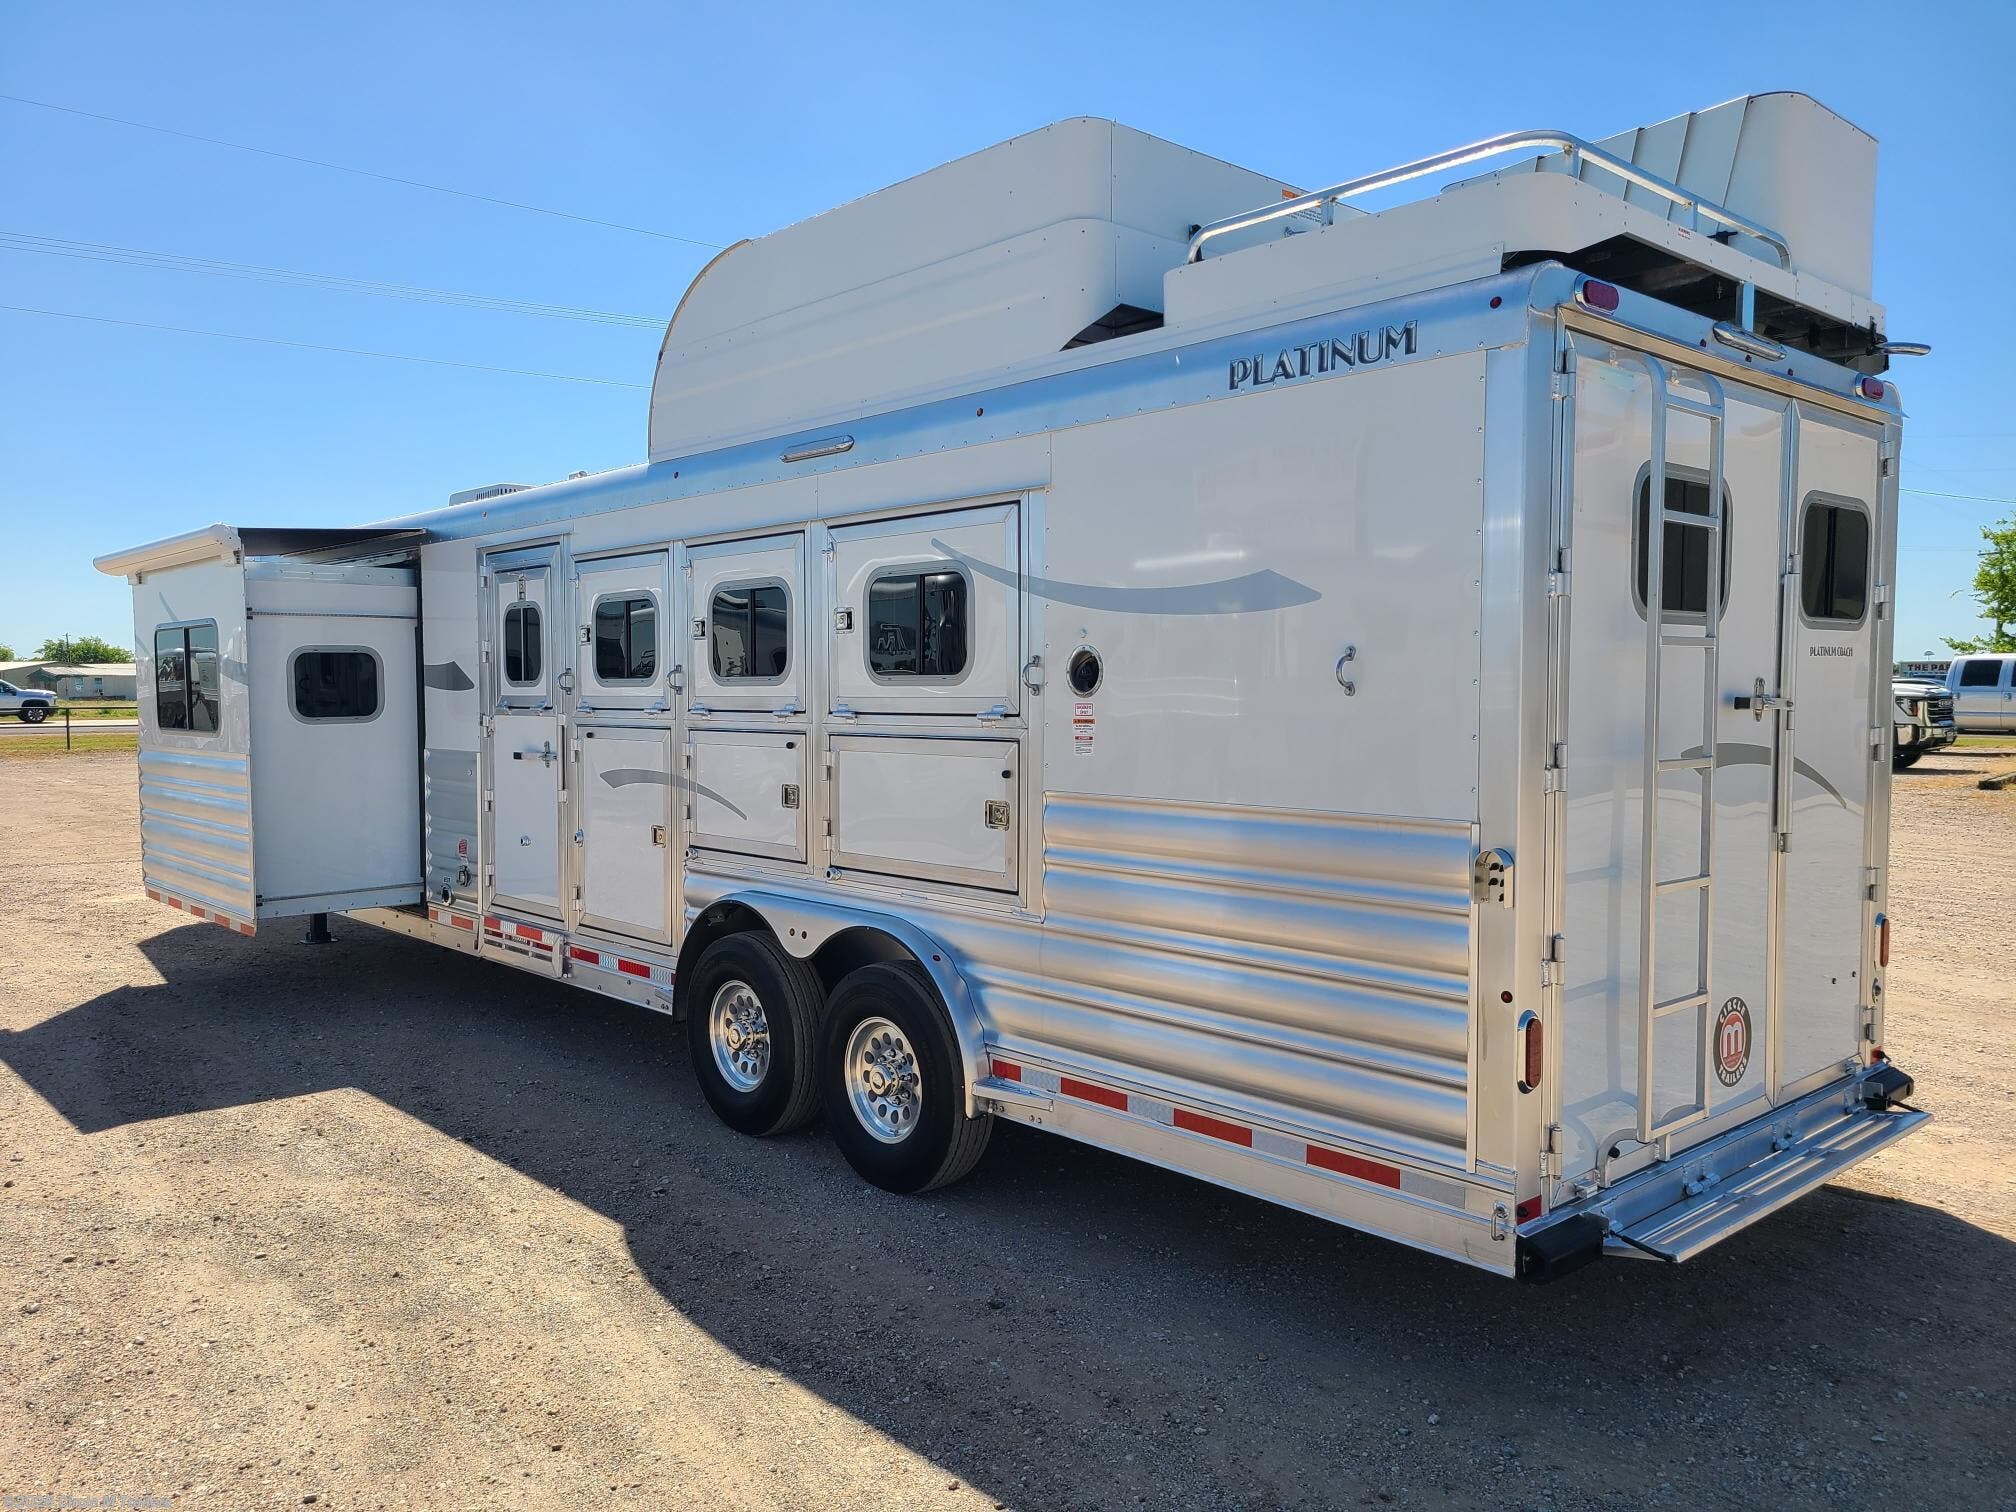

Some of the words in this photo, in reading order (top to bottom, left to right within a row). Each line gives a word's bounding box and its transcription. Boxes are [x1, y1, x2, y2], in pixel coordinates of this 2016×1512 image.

[1229, 319, 1418, 390] PLATINUM
[1809, 646, 1836, 657] PLATINUM
[1719, 999, 1746, 1022] CIRCLE
[1718, 1058, 1747, 1084] TRAILERS
